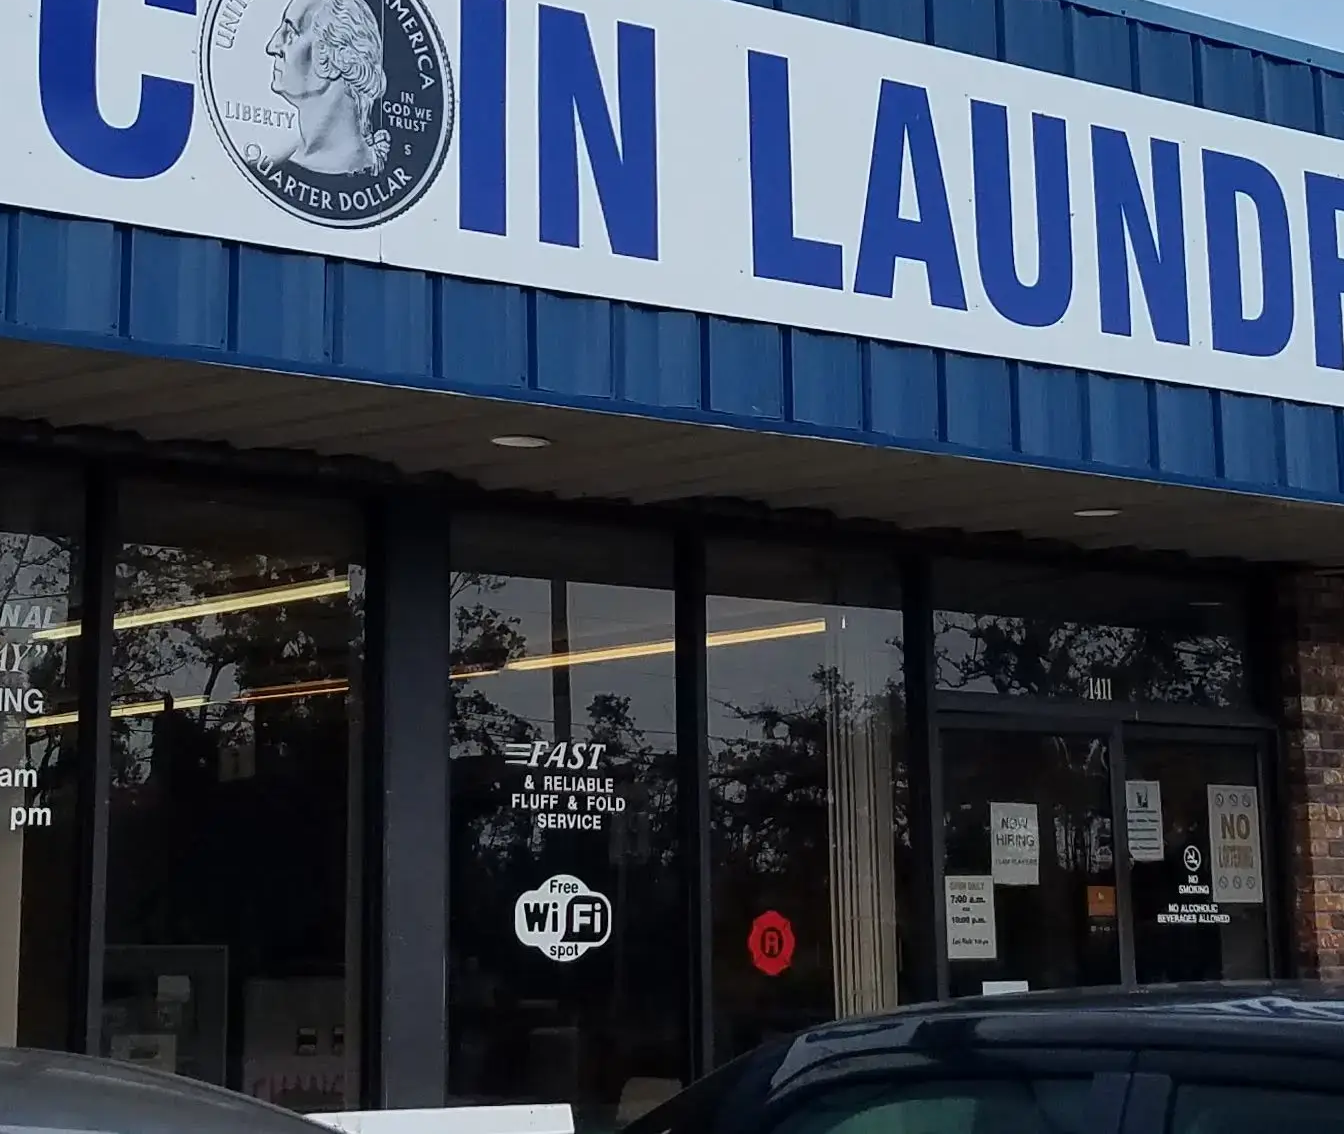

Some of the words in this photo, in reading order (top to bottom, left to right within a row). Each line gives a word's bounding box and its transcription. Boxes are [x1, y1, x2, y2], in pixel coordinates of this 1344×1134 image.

[400, 91, 415, 104] IN
[225, 100, 296, 129] LIBERTY
[382, 101, 411, 116] GOD
[414, 107, 433, 122] WE
[388, 114, 428, 133] TRUST
[244, 143, 333, 210] QUARTER
[339, 167, 413, 212] DOLLAR
[1088, 677, 1113, 701] 1411
[527, 740, 607, 771] FAST
[524, 775, 535, 790] &
[544, 776, 614, 793] RELIABLE
[511, 793, 559, 810] FLUFF
[568, 796, 578, 810] &
[587, 797, 626, 812] FOLD
[10, 807, 52, 831] pm
[537, 813, 602, 830] SERVICE
[1001, 817, 1028, 830] NOW
[1220, 813, 1251, 840] NO
[996, 834, 1035, 847] HIRING
[549, 879, 579, 894] Free
[1178, 885, 1209, 894] SMOKING
[549, 943, 579, 958] spot
